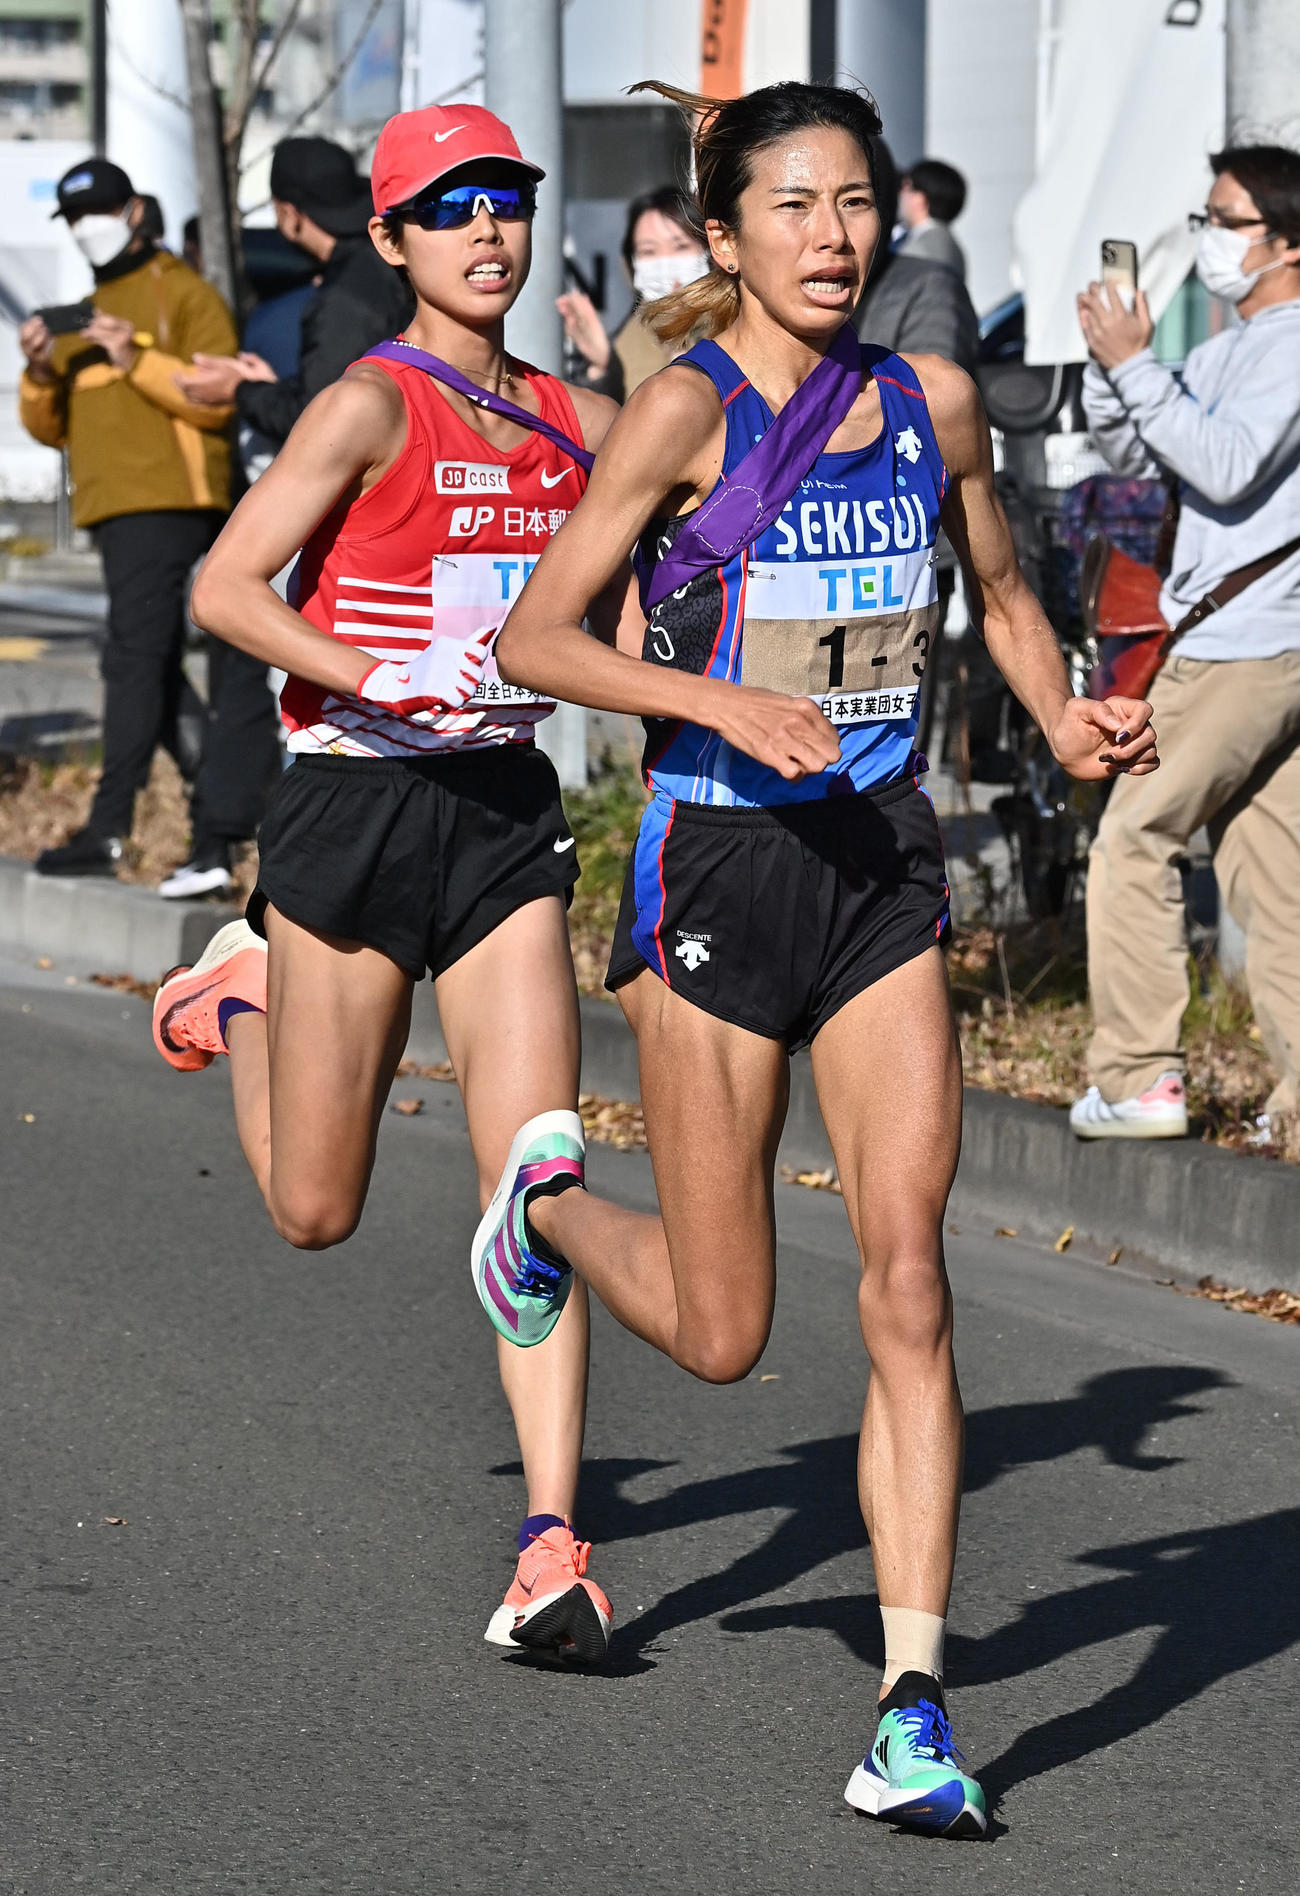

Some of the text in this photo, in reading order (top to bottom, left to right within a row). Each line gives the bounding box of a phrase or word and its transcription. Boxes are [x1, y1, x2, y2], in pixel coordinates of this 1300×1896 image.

[443, 469, 504, 487] JP cast
[448, 506, 573, 537] JP 日本郵
[774, 494, 928, 554] SEKISUI
[819, 565, 903, 611] TEL
[676, 930, 712, 941] DESCENTE
